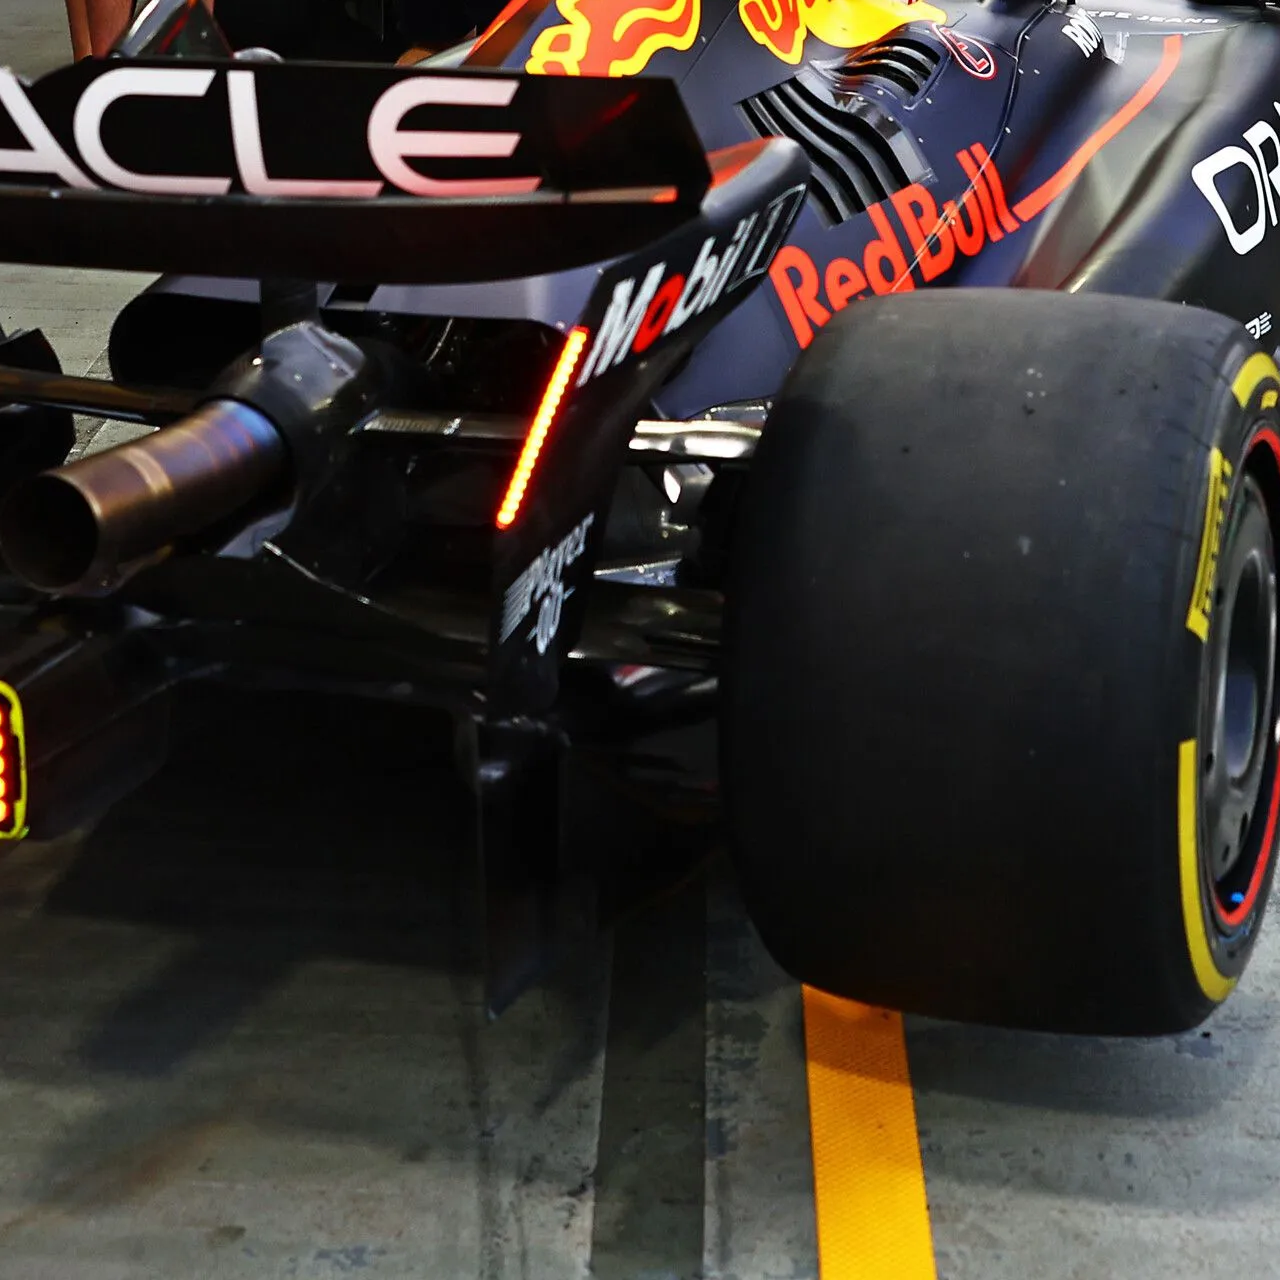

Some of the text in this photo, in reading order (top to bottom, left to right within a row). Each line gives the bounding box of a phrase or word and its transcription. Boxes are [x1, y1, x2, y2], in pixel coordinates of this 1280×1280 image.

[1137, 14, 1220, 24] JEANS
[576, 211, 758, 388] Mobil
[770, 141, 1022, 350] Red Bull
